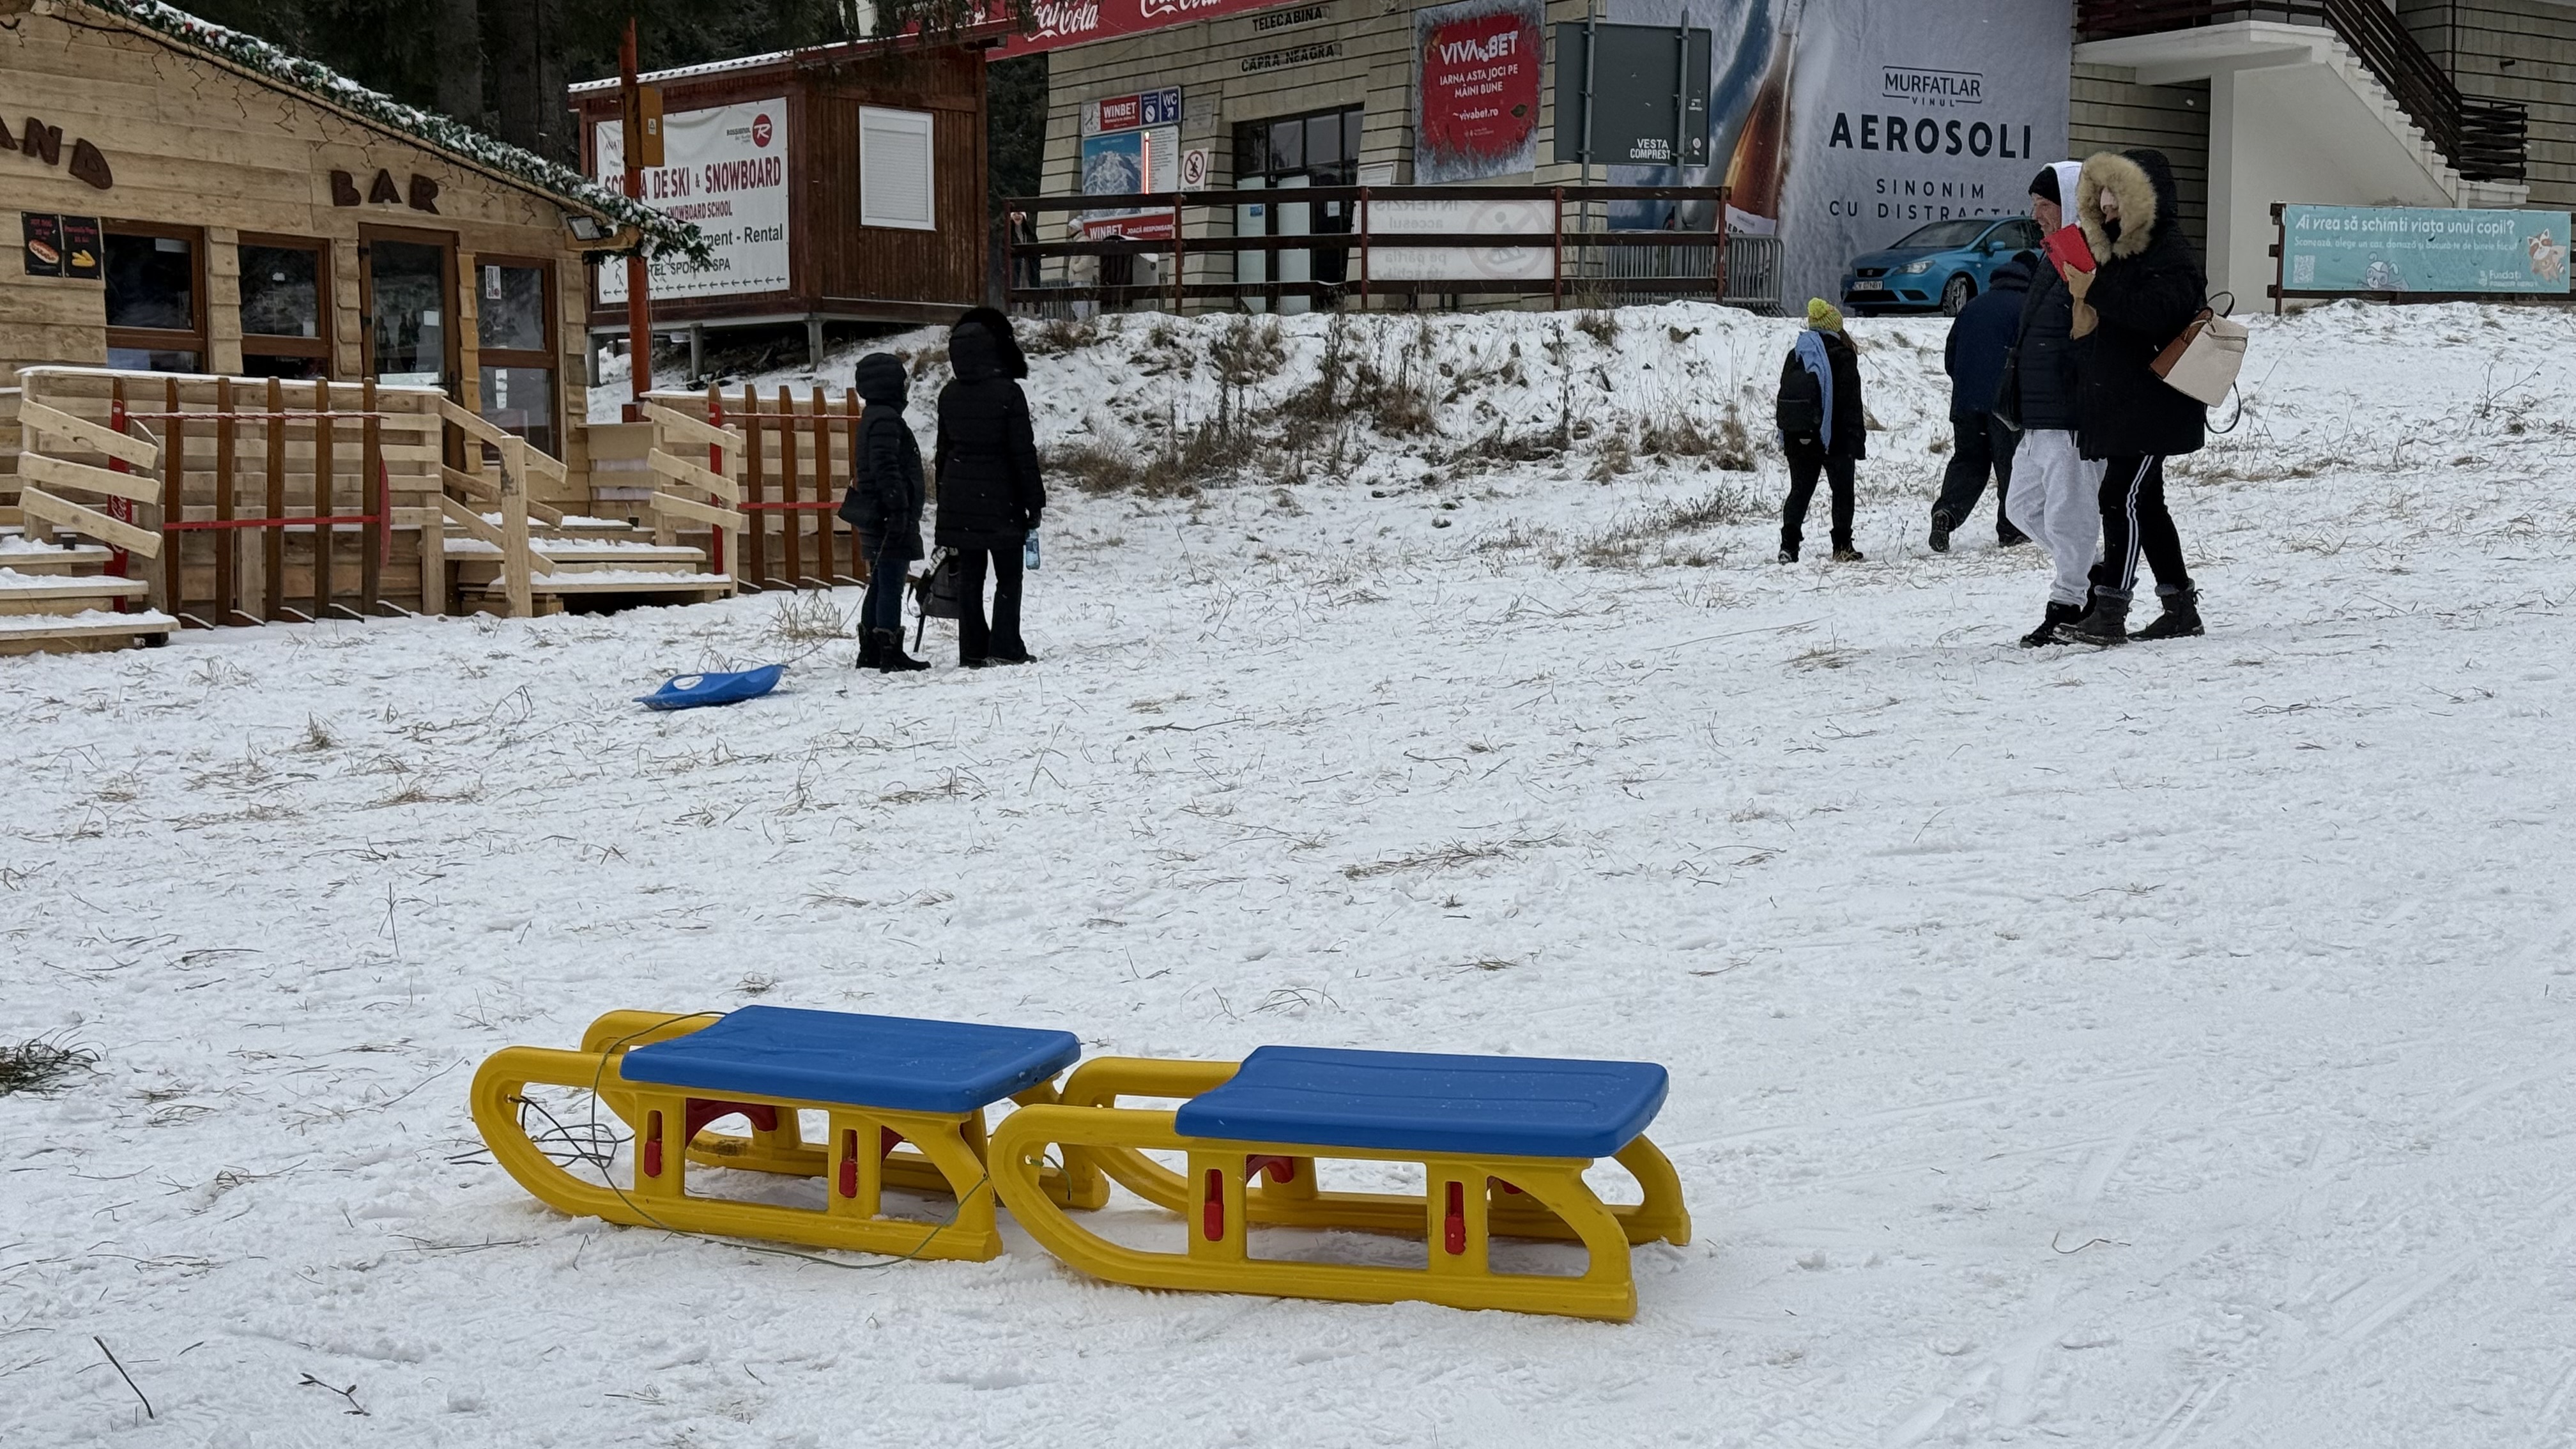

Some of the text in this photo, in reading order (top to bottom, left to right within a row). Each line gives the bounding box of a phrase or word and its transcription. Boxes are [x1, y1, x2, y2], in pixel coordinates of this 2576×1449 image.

[1252, 6, 1322, 32] TELECABINA
[1241, 44, 1335, 72] CAPRA NEAGRA
[1439, 64, 1519, 86] IARNA ASTA JOCI PE
[1455, 80, 1503, 98] MÂINI BUNE
[1885, 72, 1981, 97] MURFATLAR
[1163, 93, 1177, 106] WC
[1912, 96, 1955, 107] VINUL
[1103, 102, 1137, 119] WINBET
[1459, 107, 1499, 121] vivabet.ro
[1637, 138, 1669, 149] VESTA
[1828, 112, 2031, 160] AEROSOLI
[1630, 148, 1671, 160] COMPREST
[604, 156, 781, 200] SCOA DE SKI & SNOWBOARD
[330, 168, 441, 215] BAR
[1876, 178, 1984, 199] SINONIM
[707, 200, 733, 218] SCHOOL
[1828, 200, 1858, 217] CU
[744, 223, 783, 243] Rental
[2295, 213, 2310, 230] Ai
[2313, 216, 2340, 231] vrea
[2343, 215, 2358, 231] să
[2447, 218, 2474, 234] unui
[2476, 218, 2515, 238] copil?
[2335, 236, 2356, 250] alege
[2462, 239, 2472, 250] de
[712, 257, 731, 272] SPA
